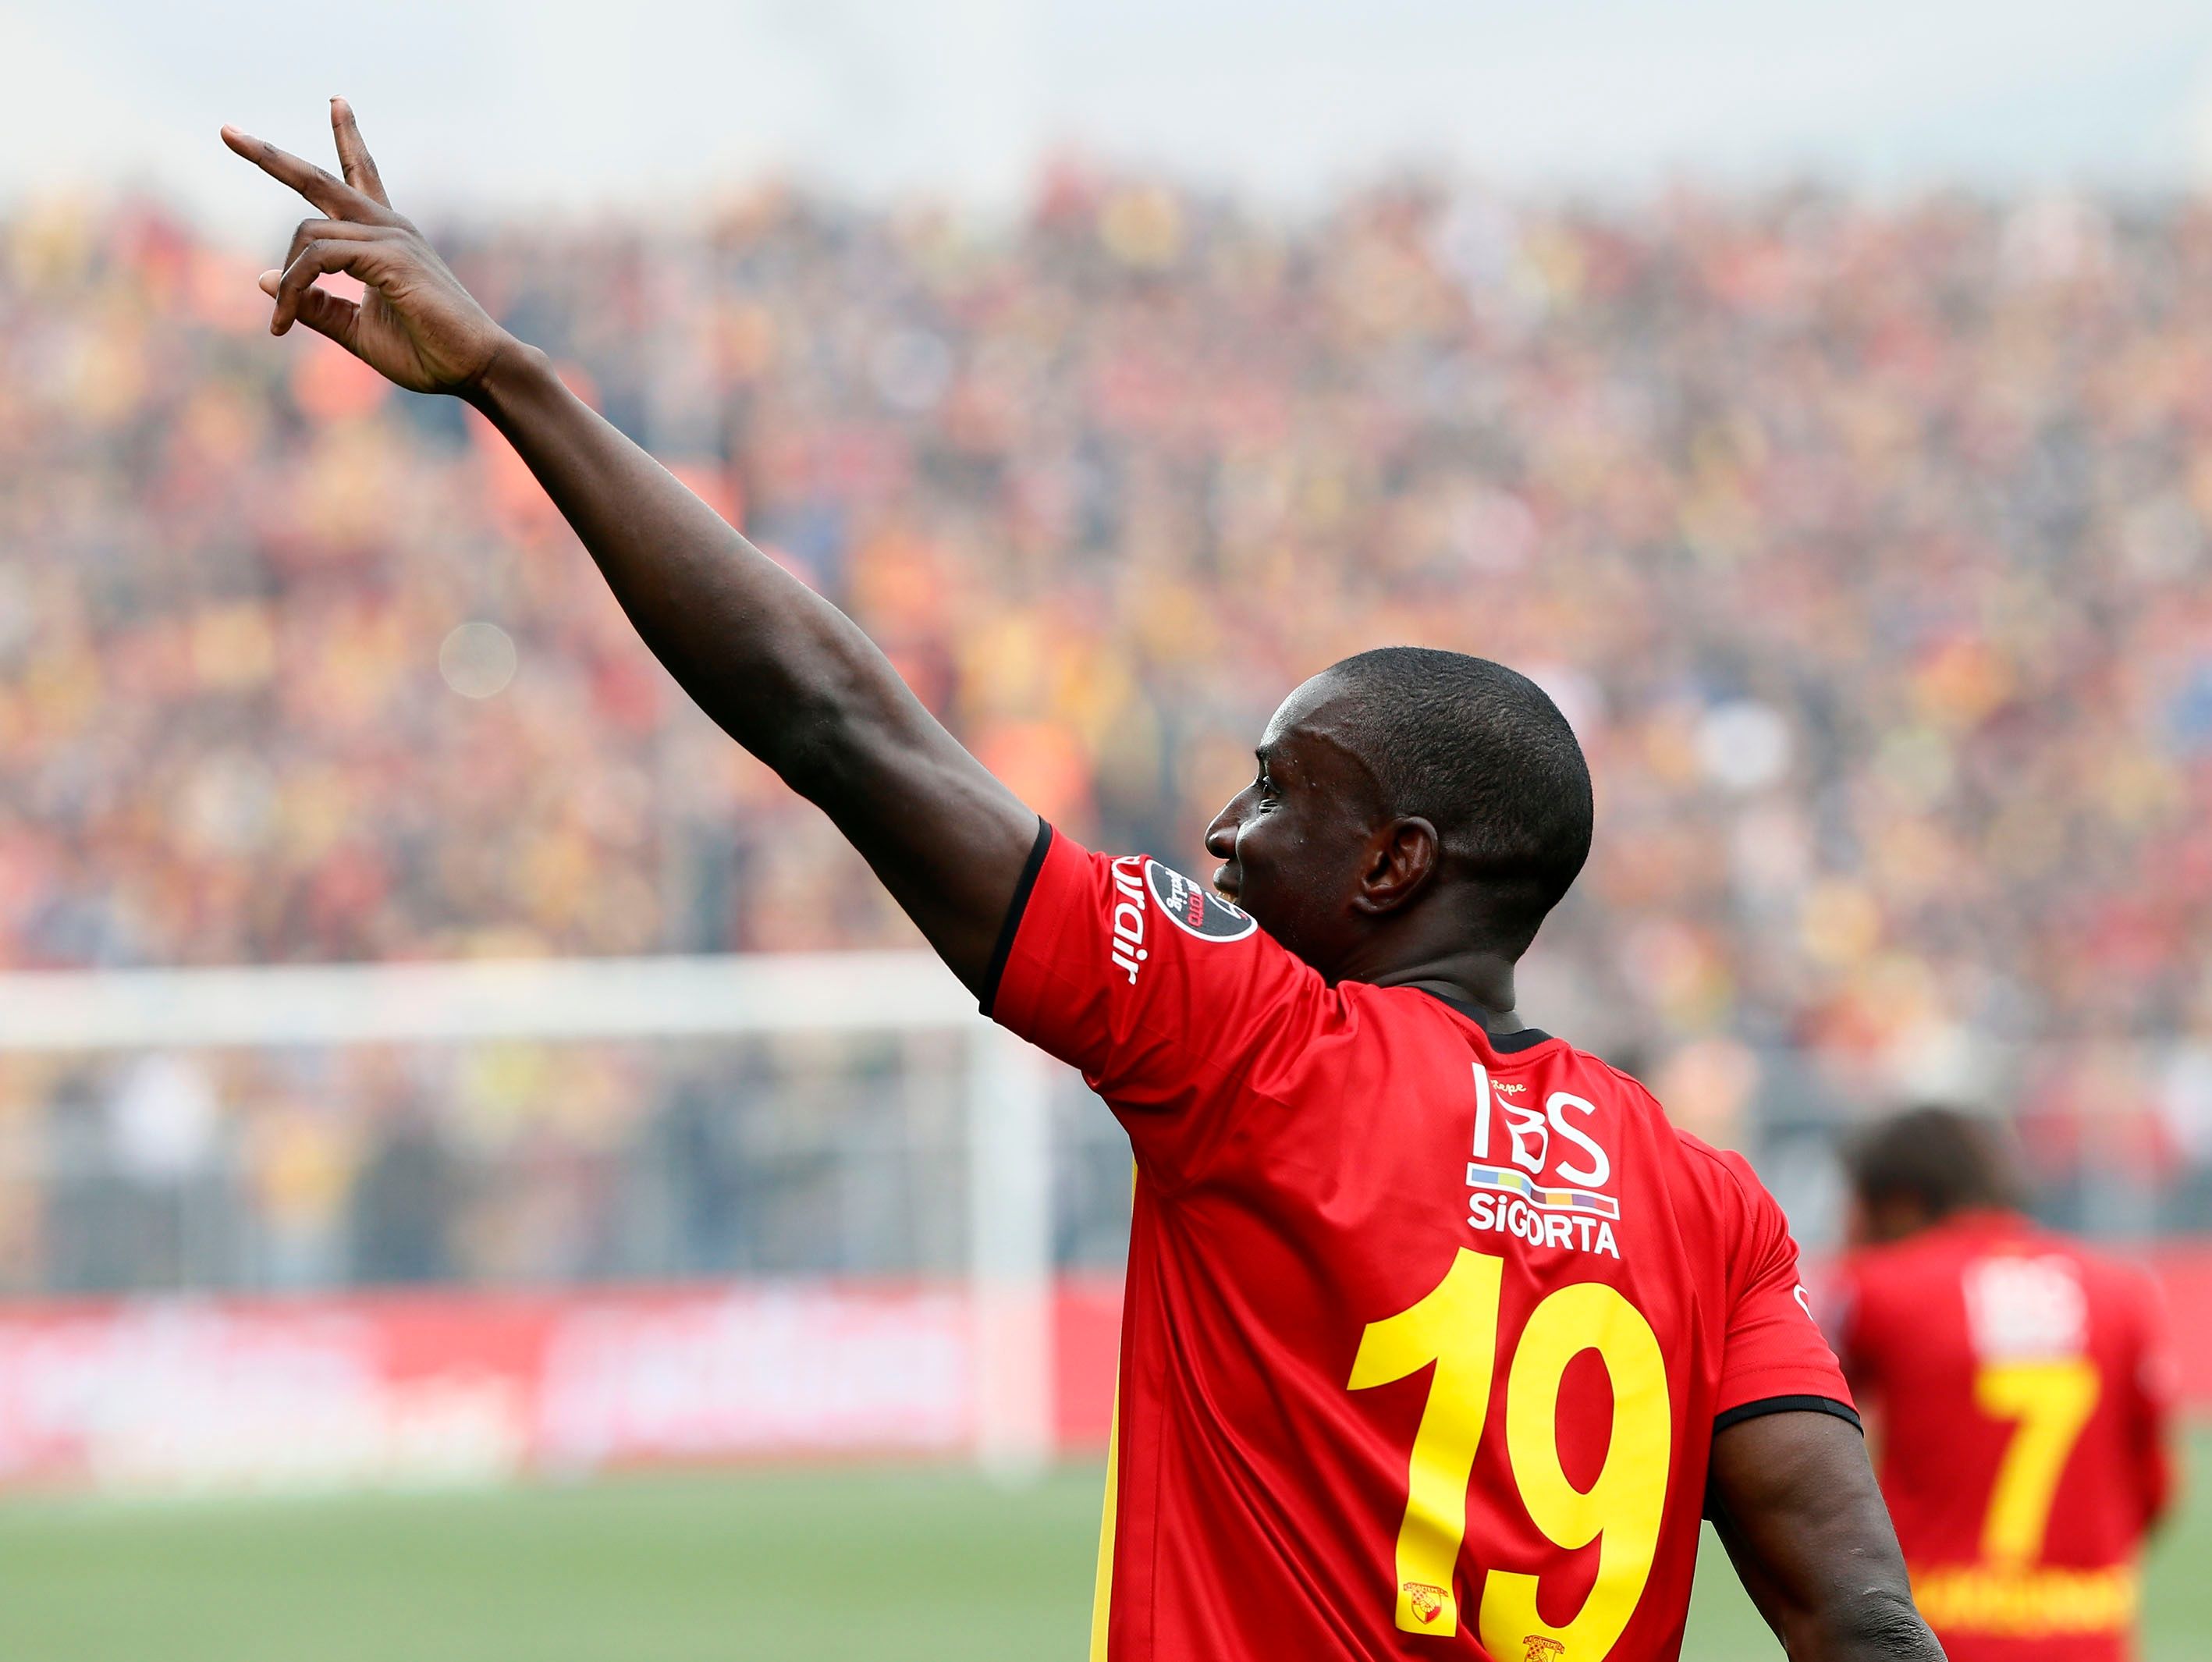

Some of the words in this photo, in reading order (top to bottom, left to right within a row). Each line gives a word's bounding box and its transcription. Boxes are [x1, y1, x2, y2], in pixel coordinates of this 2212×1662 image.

[1111, 856, 1148, 985] urair
[1347, 1246, 1671, 1662] 19
[1972, 1361, 2100, 1570] 7
